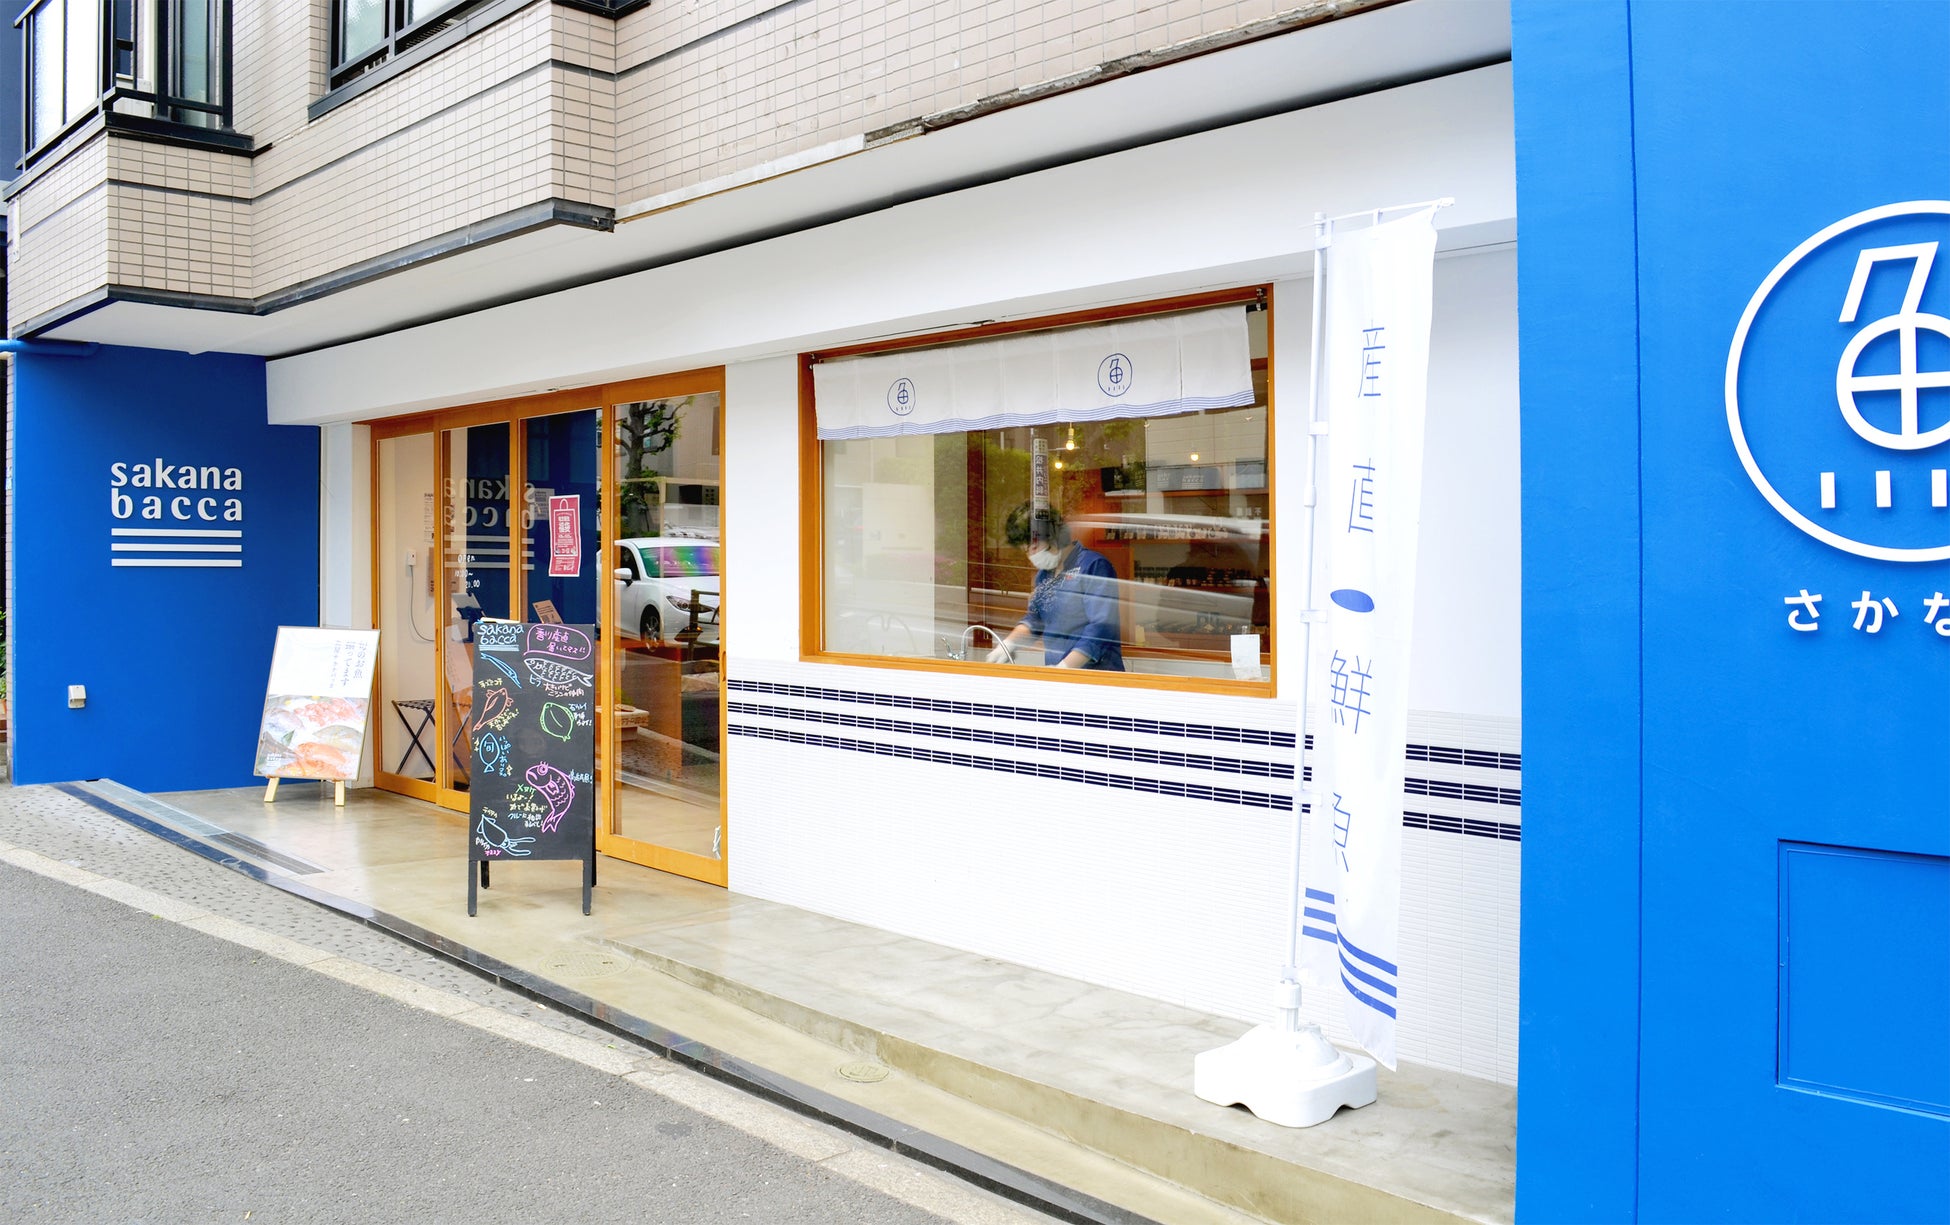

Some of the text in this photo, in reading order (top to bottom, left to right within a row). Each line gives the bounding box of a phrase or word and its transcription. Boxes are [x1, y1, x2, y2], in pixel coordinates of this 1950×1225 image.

[110, 458, 243, 491] sakana
[111, 487, 243, 521] bacca
[477, 624, 524, 635] sakana
[480, 634, 518, 645] bacca
